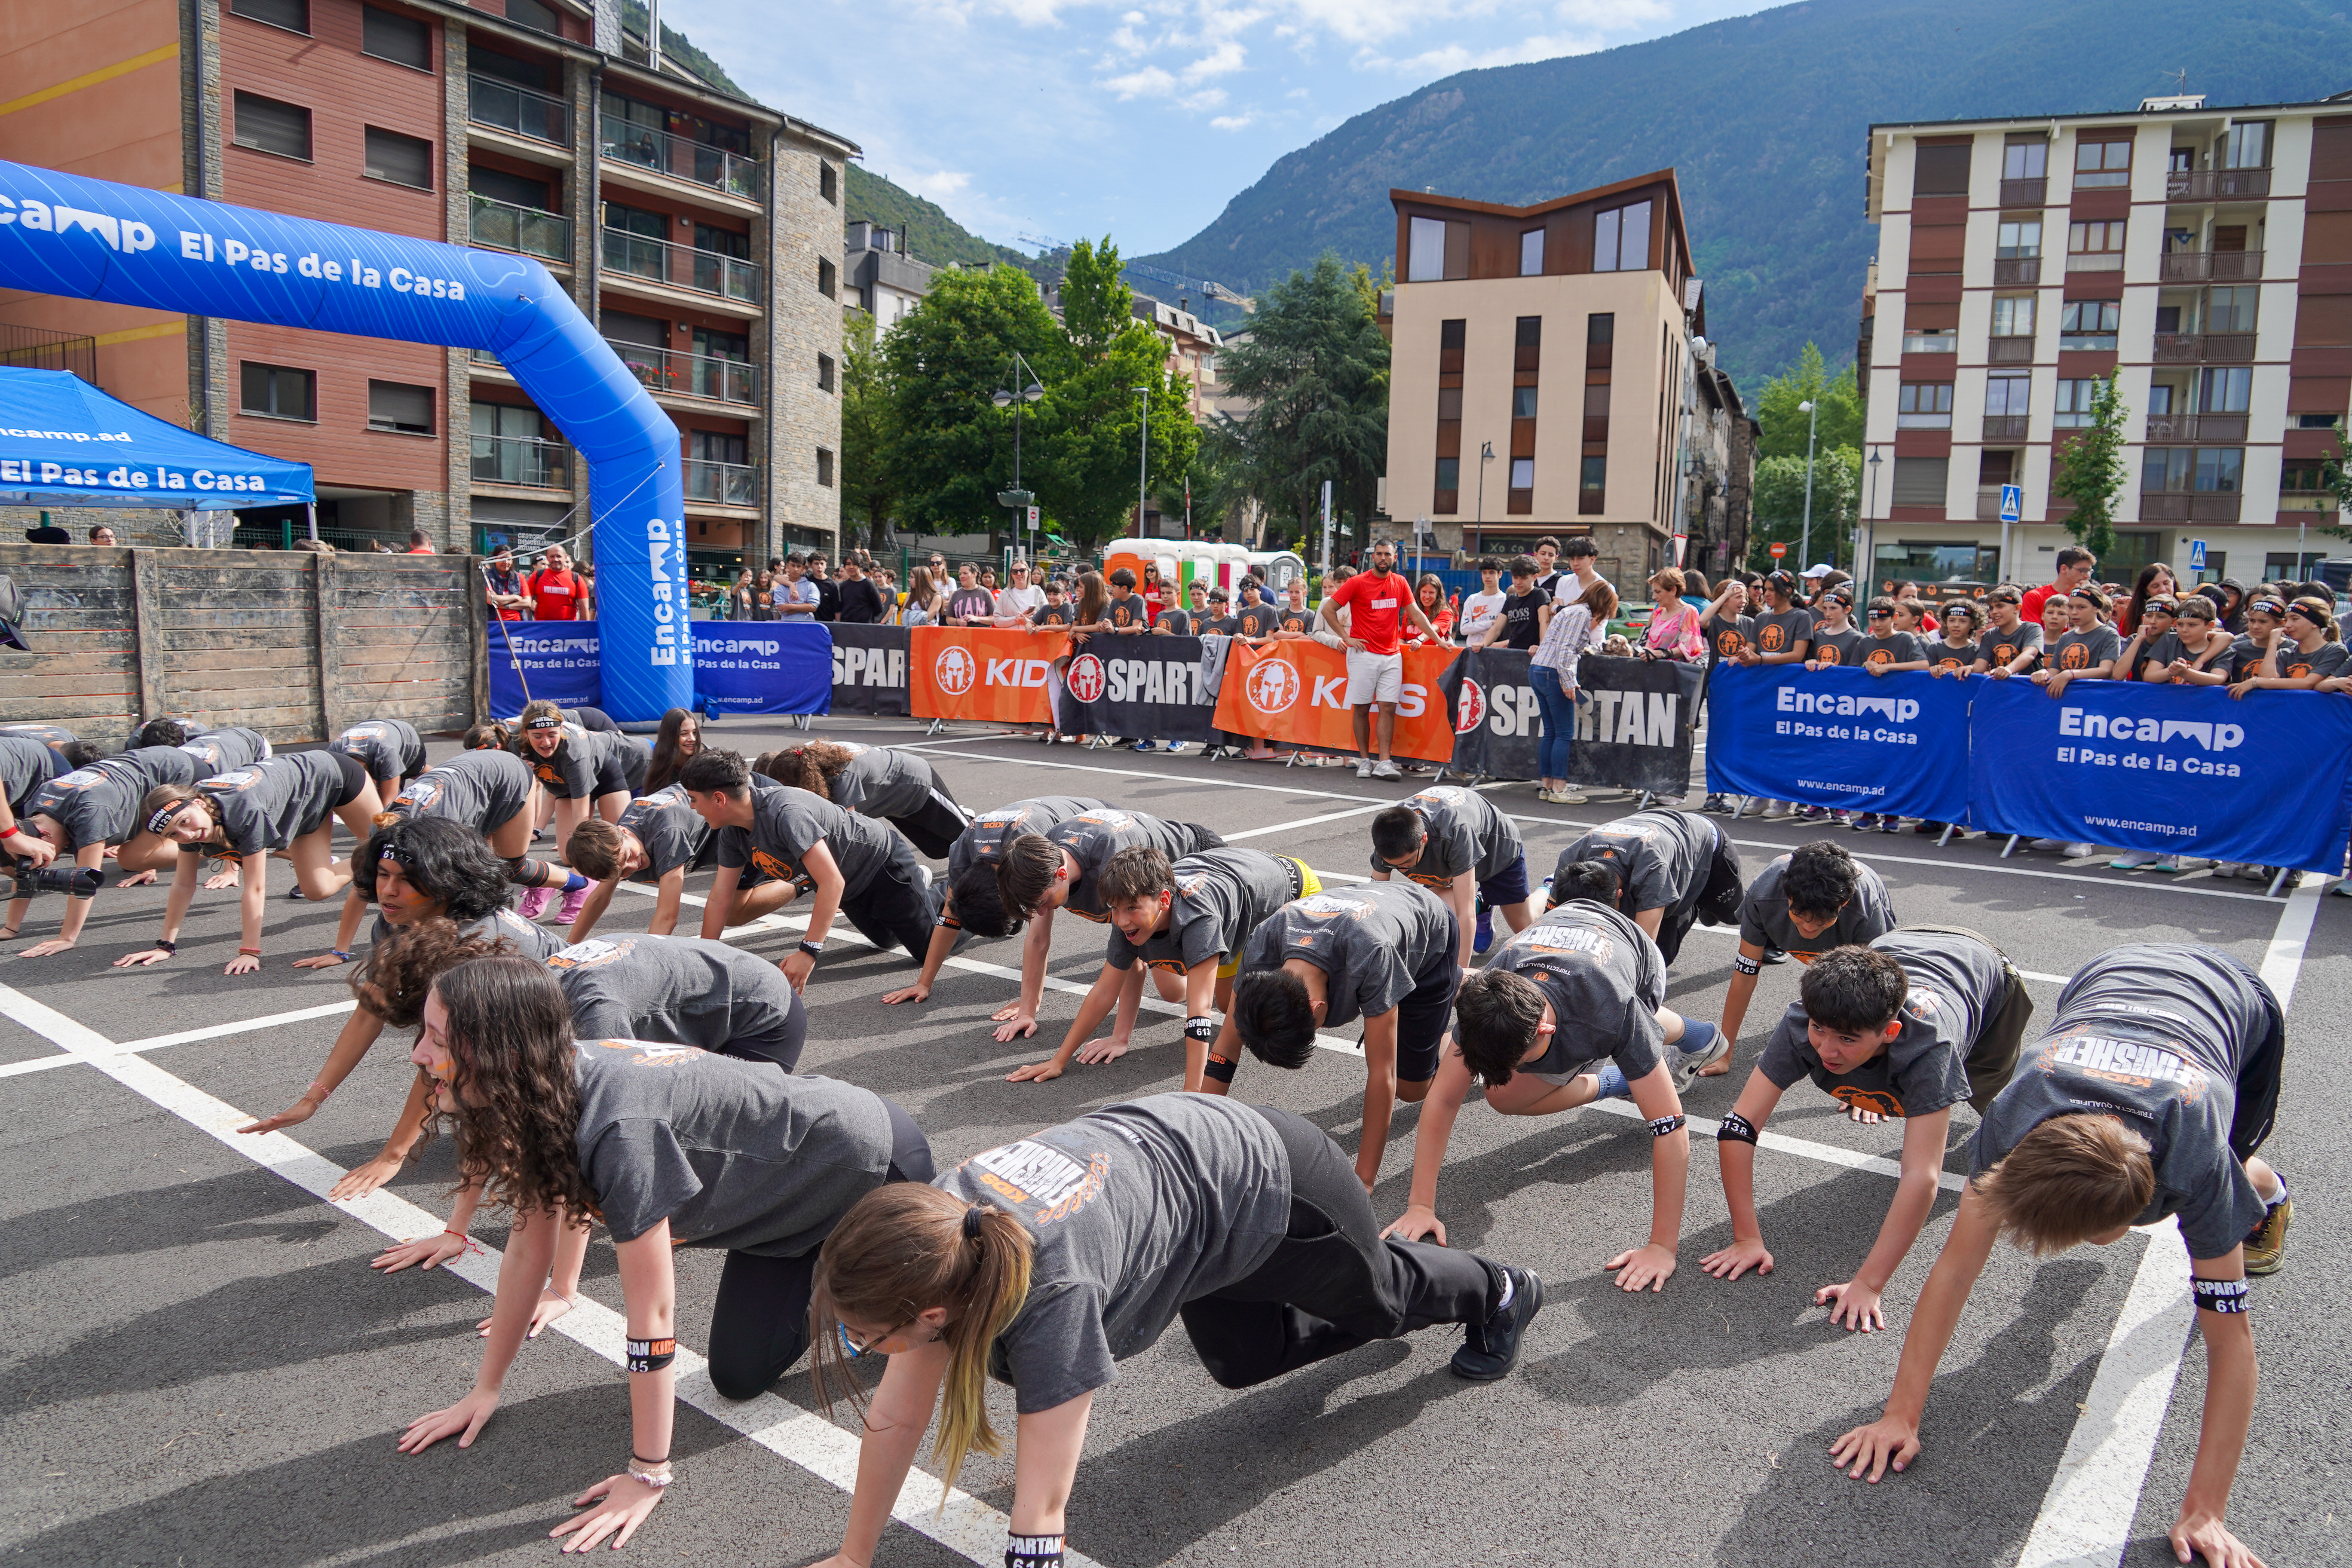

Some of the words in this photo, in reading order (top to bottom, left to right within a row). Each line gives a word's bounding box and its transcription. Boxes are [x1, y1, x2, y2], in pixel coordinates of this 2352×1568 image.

[179, 230, 214, 262] El
[225, 238, 289, 274] Pas
[298, 252, 342, 281] de
[351, 258, 381, 289] la
[388, 267, 465, 301] Casa
[1, 460, 31, 482] El
[41, 462, 99, 485] Pas
[108, 466, 148, 488] de
[157, 467, 186, 489] la
[192, 469, 265, 492] Casa
[675, 519, 684, 563] Casa
[677, 566, 685, 582] la
[543, 586, 569, 595] VOLUNTEER
[647, 518, 676, 666] Encamp
[680, 587, 687, 610] de
[1371, 598, 1397, 610] VOLUNTEER
[1508, 607, 1530, 620] BOSS
[524, 659, 544, 669] Pas
[547, 659, 562, 668] de
[564, 659, 574, 667] la
[682, 649, 691, 664] El
[697, 659, 717, 668] Pas
[720, 659, 736, 669] de
[738, 659, 749, 669] la
[751, 660, 780, 669] Casa
[1777, 686, 1920, 723] Encamp
[1490, 684, 1677, 748] SPRTAN
[1776, 721, 1790, 734] El
[1794, 722, 1823, 738] Pas
[1827, 724, 1850, 739] de
[1854, 726, 1870, 741] la
[1874, 728, 1918, 745] Casa
[2059, 707, 2244, 752] Encamp
[2057, 747, 2075, 762] El
[2080, 748, 2117, 767] Pas
[2123, 752, 2150, 770] de
[2157, 754, 2178, 772] la
[2182, 757, 2241, 777] Casa
[1797, 779, 1885, 796] www.encamp.ad
[163, 800, 182, 811] KIDS
[156, 814, 172, 832] 6129
[1078, 816, 1104, 825] KIDS
[2084, 814, 2198, 837] www.encamp.ad
[1302, 909, 1339, 918] KIDS
[1531, 945, 1576, 954] KIDS
[1545, 965, 1571, 975] TRIFECTA
[2053, 1037, 2196, 1088] FINISHER
[2082, 1067, 2152, 1088] KIDS
[2069, 1098, 2113, 1109] QUALIFIER
[2116, 1104, 2154, 1119] TRIFECTA
[973, 1140, 1088, 1208] FINISHER
[979, 1173, 1030, 1203] KIDS
[651, 1339, 676, 1355] KIDS
